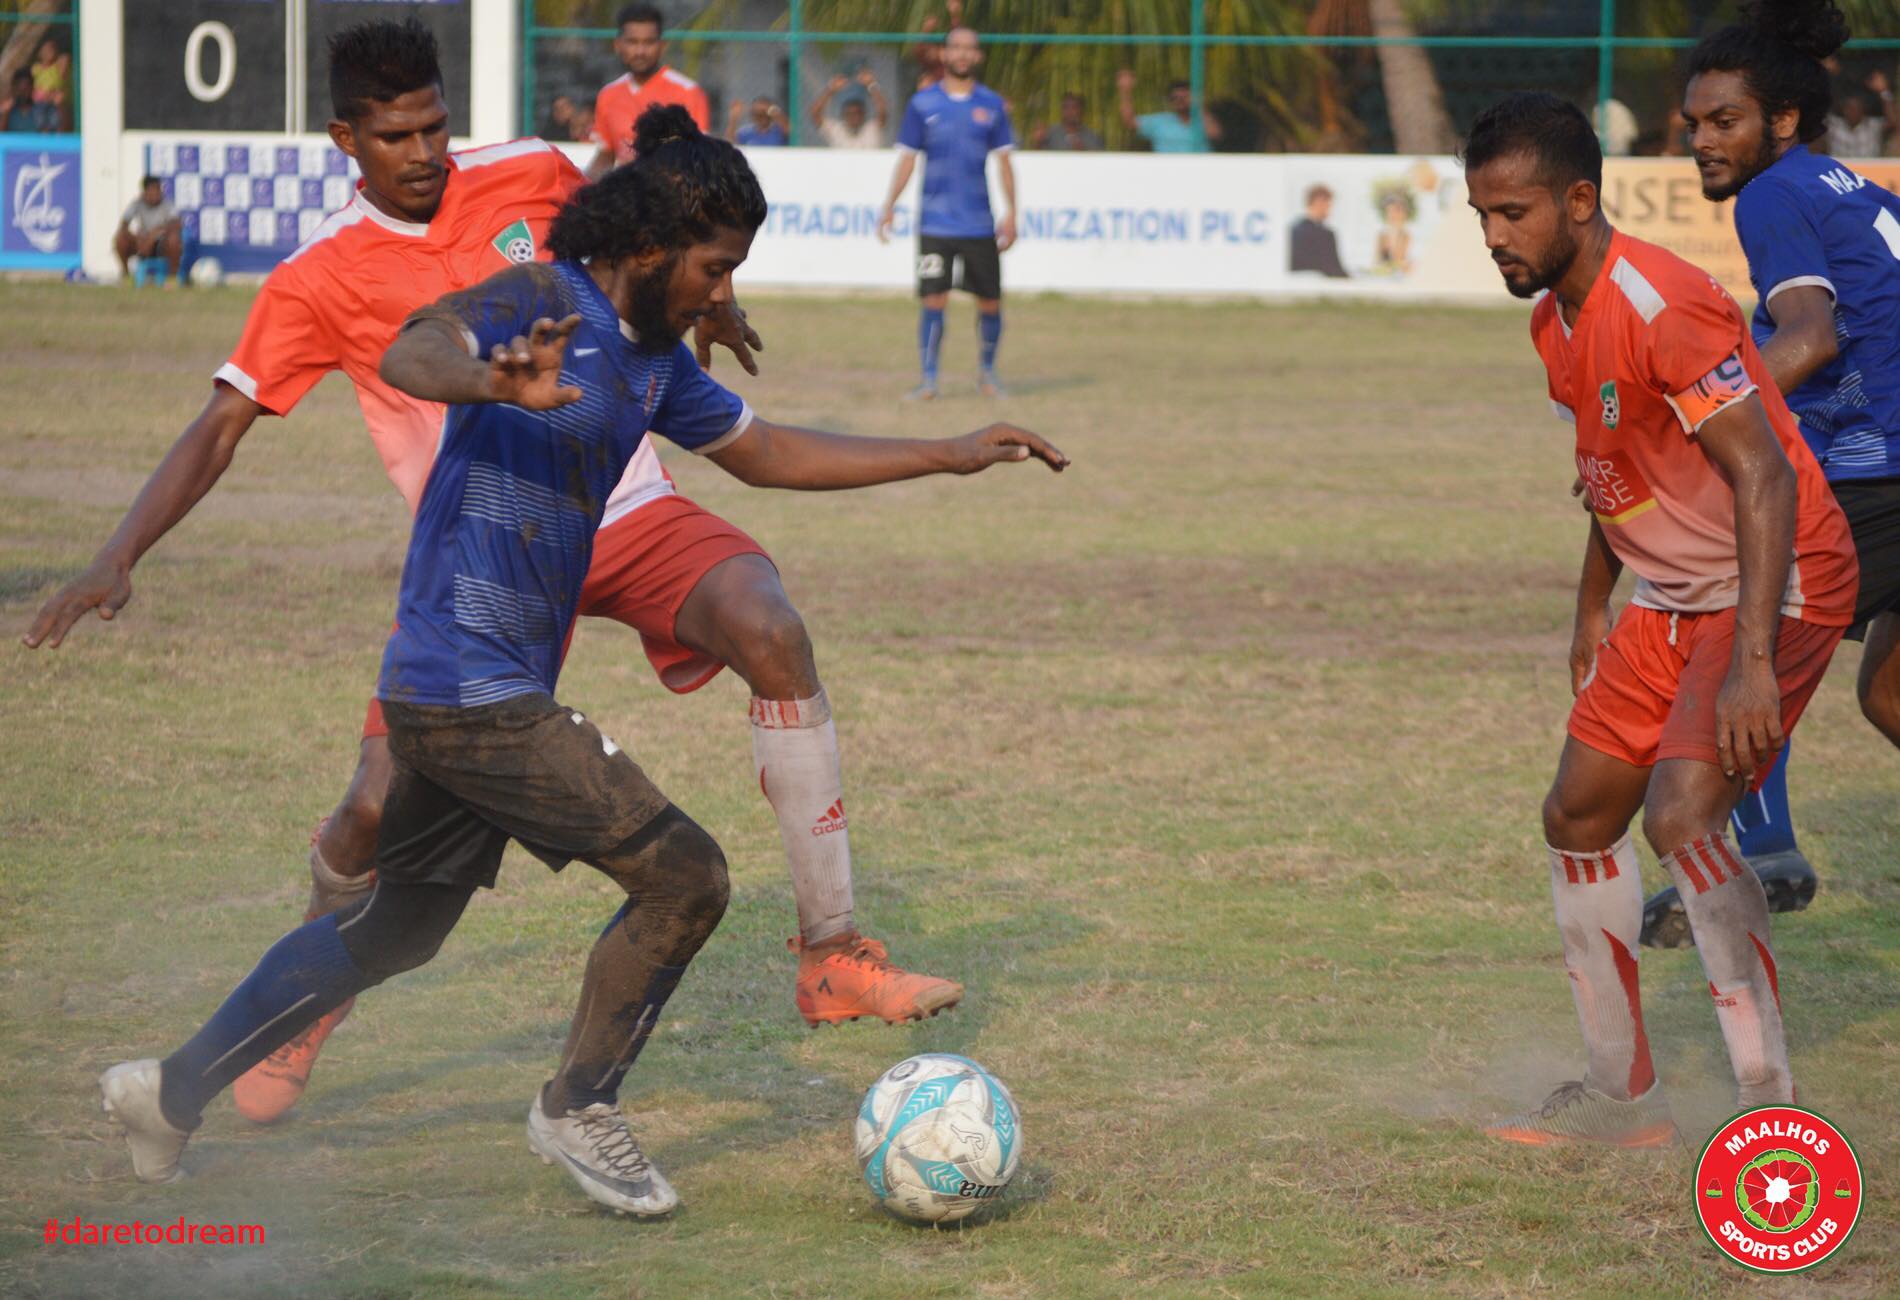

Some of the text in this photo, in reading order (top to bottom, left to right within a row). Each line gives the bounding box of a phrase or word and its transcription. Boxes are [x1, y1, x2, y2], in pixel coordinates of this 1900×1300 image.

[184, 20, 237, 102] 0
[766, 203, 913, 238] TRADING
[1201, 209, 1269, 243] PLC
